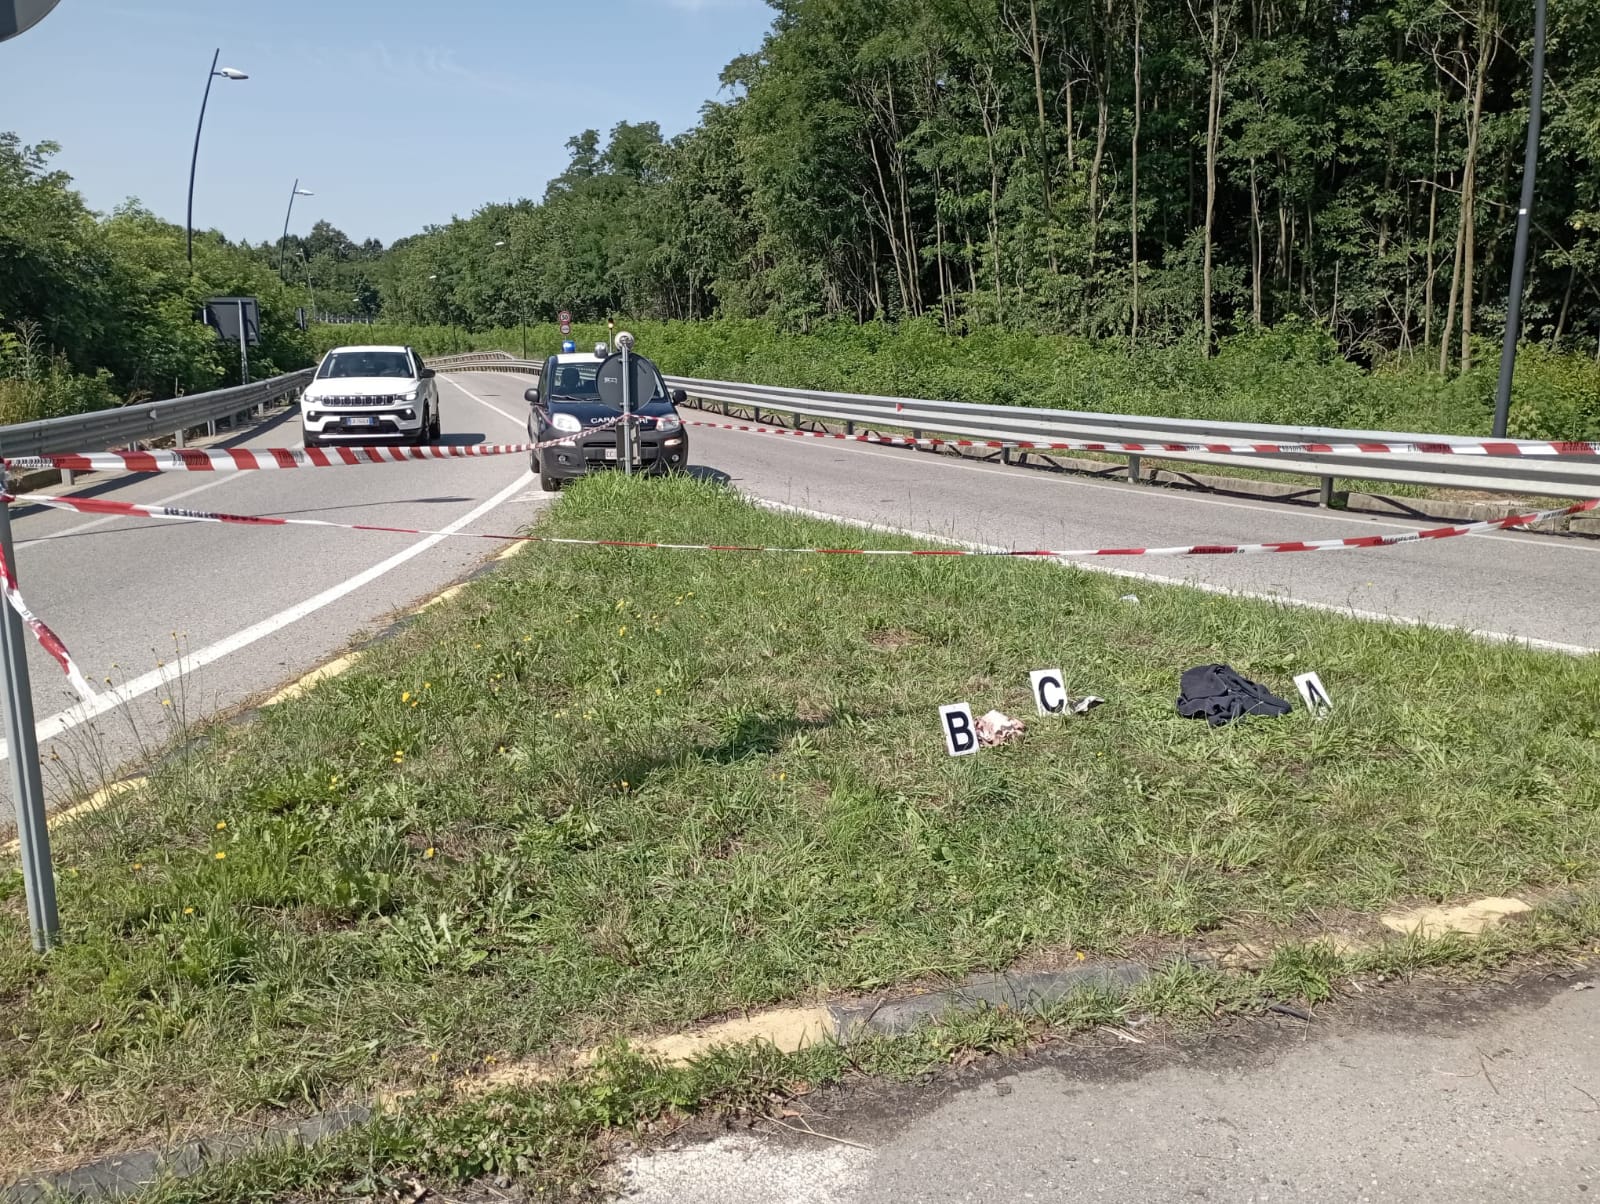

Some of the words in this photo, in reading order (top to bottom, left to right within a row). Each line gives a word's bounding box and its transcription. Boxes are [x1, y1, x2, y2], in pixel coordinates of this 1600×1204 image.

[1038, 675, 1064, 713] C
[1305, 679, 1333, 713] A
[945, 710, 974, 752] B
